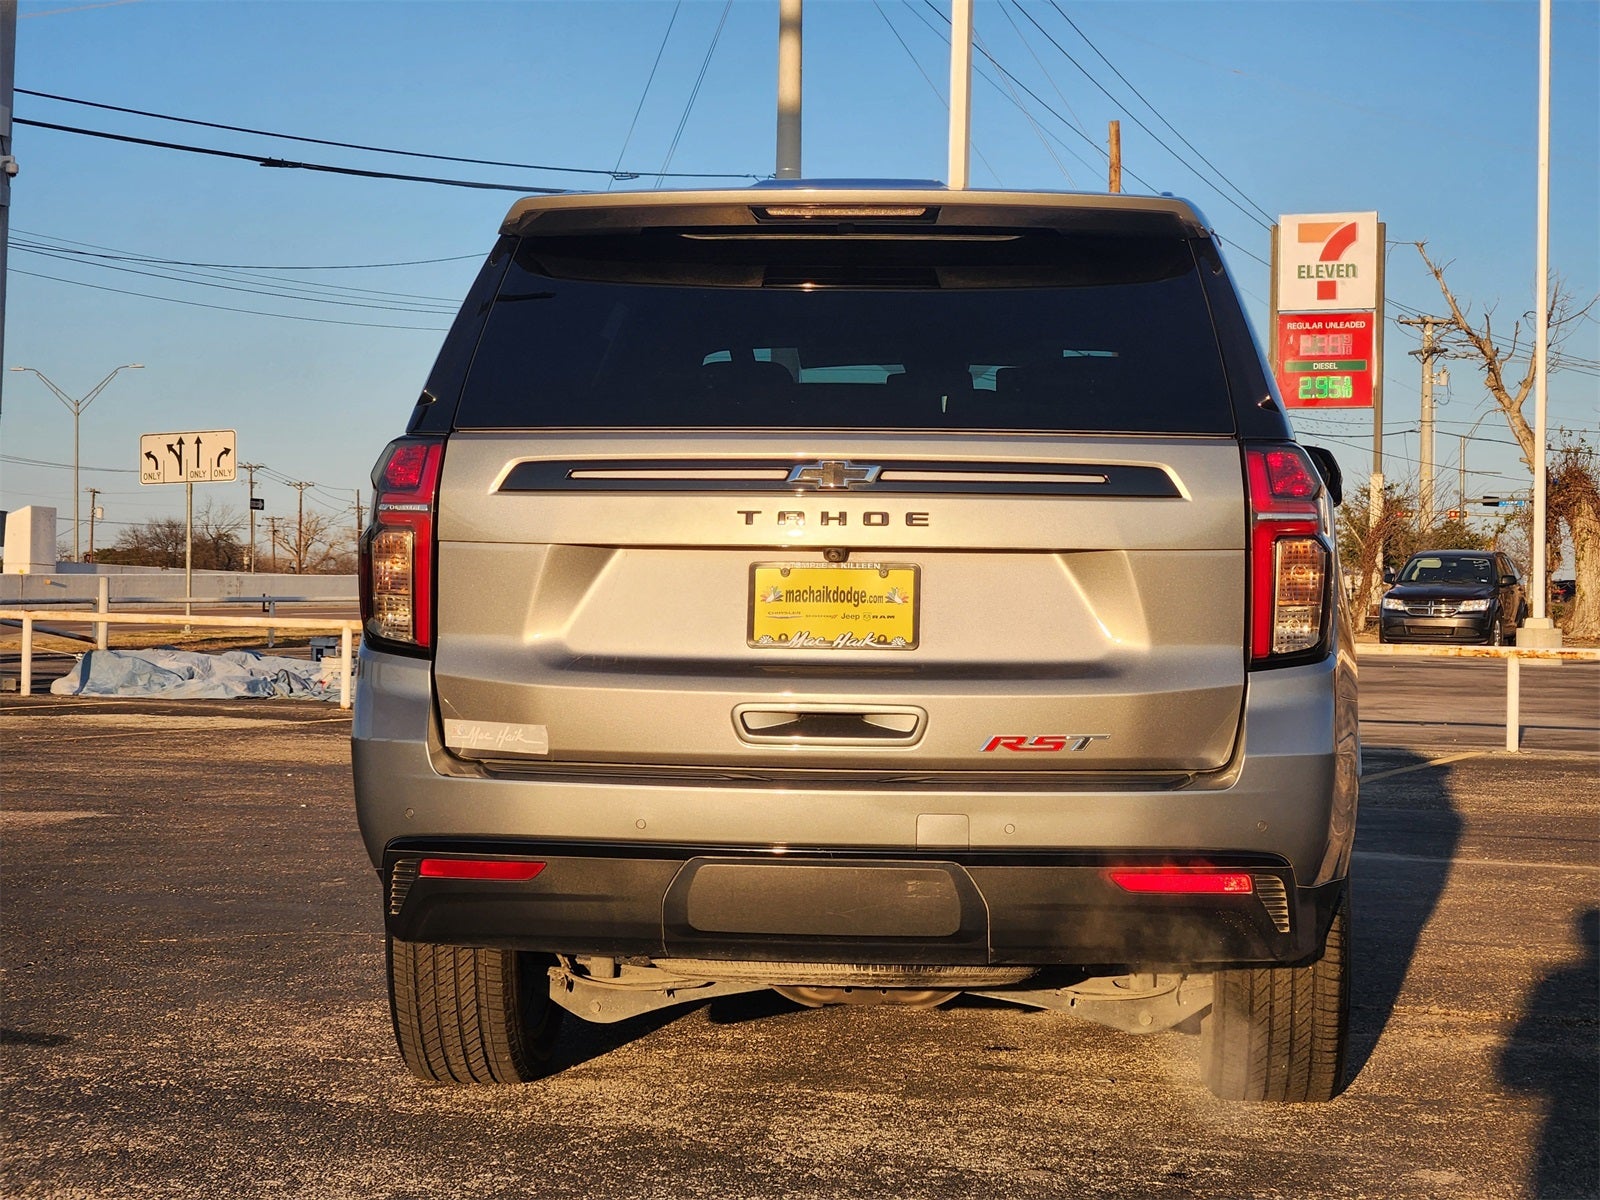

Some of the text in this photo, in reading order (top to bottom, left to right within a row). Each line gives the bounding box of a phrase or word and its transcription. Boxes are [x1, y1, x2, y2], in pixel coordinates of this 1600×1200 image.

[1298, 222, 1358, 262] 7
[1287, 321, 1366, 330] REGULAR UNLEADED
[1313, 362, 1338, 370] DIESEL
[143, 472, 161, 481] ONLY
[190, 470, 207, 478] ONLY
[213, 469, 232, 477] ONLY
[737, 510, 930, 527] TAHOE
[785, 586, 884, 607] machaikdodge.com
[786, 631, 883, 648] Mac Haik
[979, 734, 1112, 752] RST
